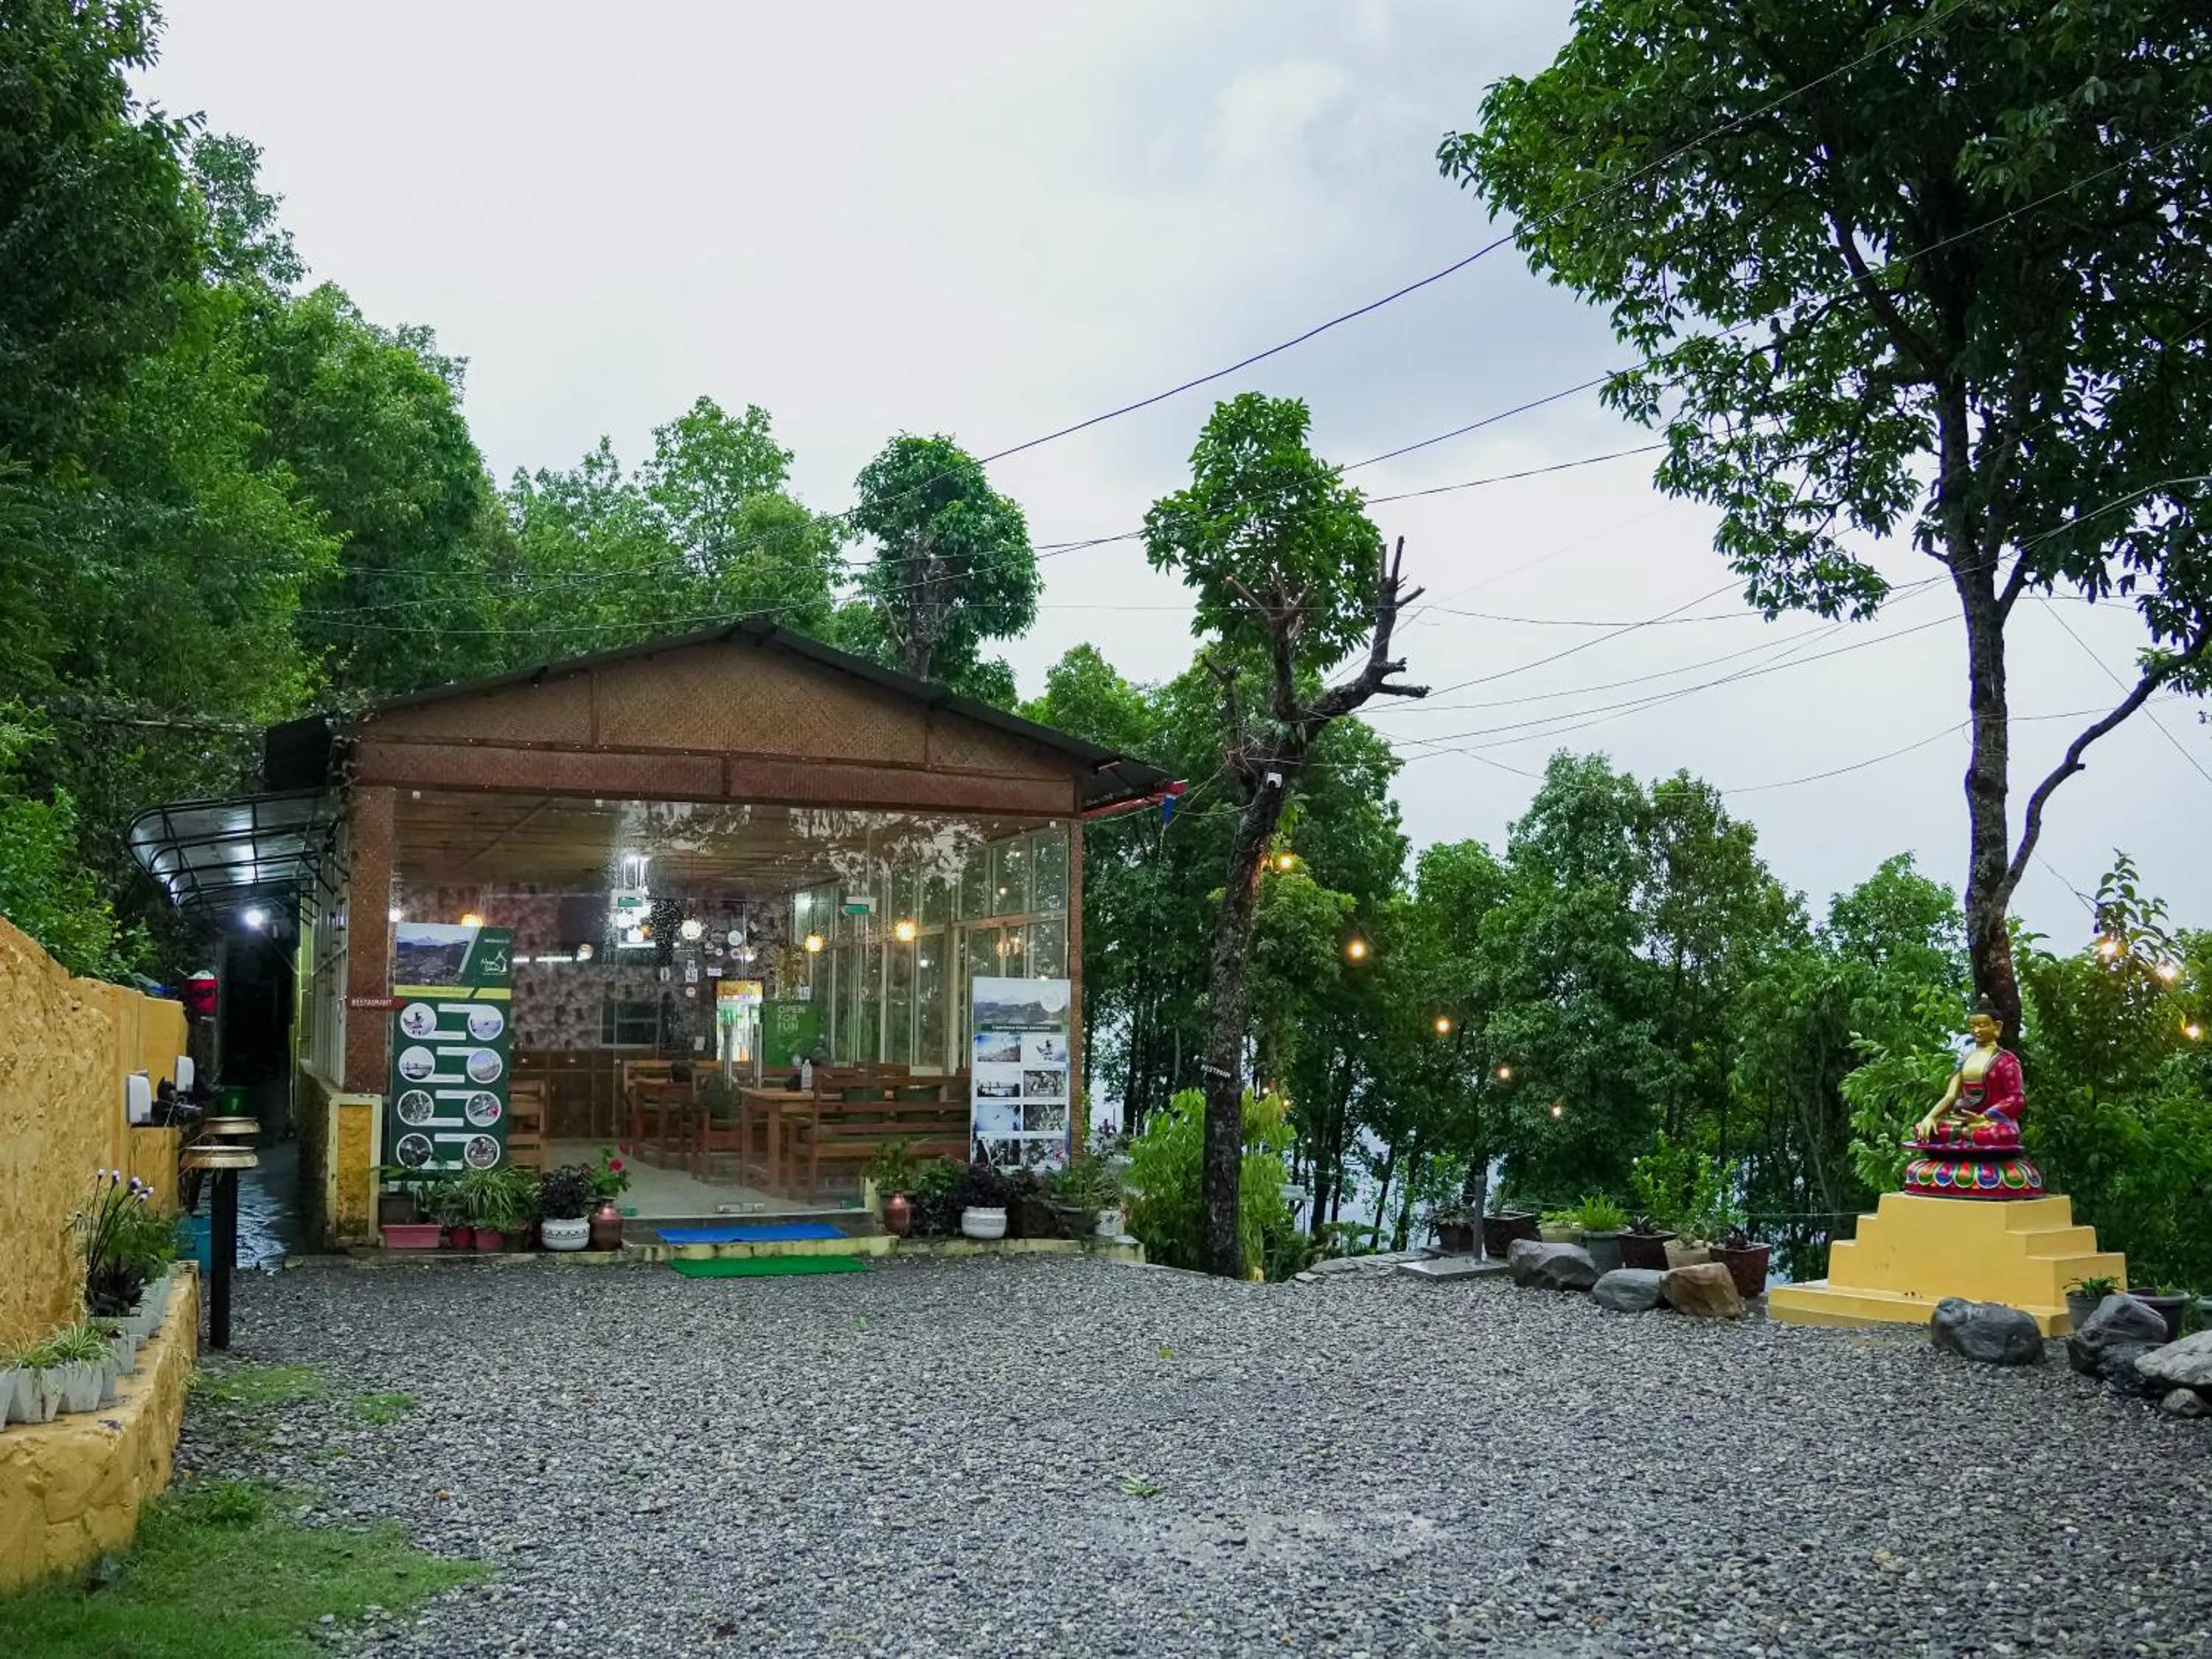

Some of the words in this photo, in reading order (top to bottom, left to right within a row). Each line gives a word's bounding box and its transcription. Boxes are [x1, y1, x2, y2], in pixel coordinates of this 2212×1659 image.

[351, 998, 392, 1007] RESTAURANT
[778, 1005, 806, 1014] OPEN
[778, 1014, 797, 1023] FOR
[778, 1023, 799, 1031] FUN
